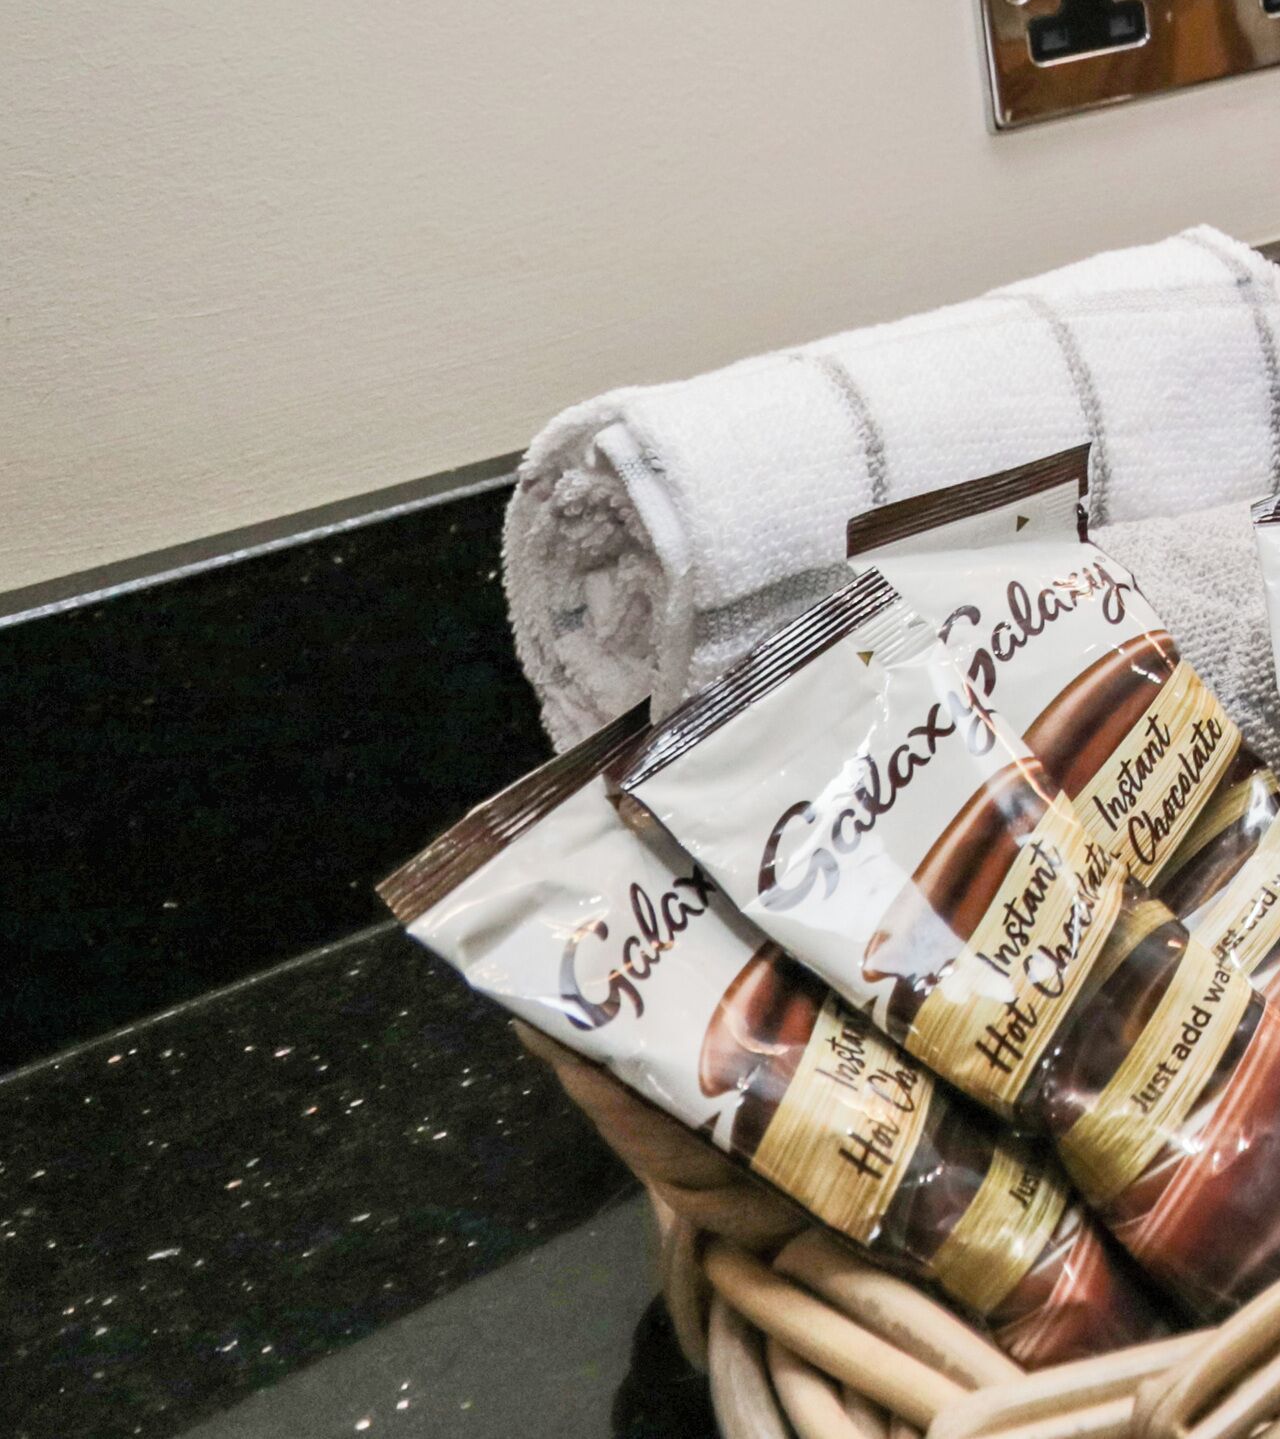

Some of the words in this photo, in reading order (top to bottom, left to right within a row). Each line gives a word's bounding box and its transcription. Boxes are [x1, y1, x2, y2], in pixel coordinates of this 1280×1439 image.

[937, 561, 1131, 698] Galaxy
[757, 690, 998, 911] Galaxy
[1098, 712, 1171, 831] Instant
[1126, 716, 1224, 865] Chocolate
[558, 863, 717, 1032] Galax
[974, 838, 1064, 979] Instant
[974, 996, 1038, 1074] Hot
[1129, 1061, 1178, 1114] Just
[1170, 1004, 1213, 1061] add
